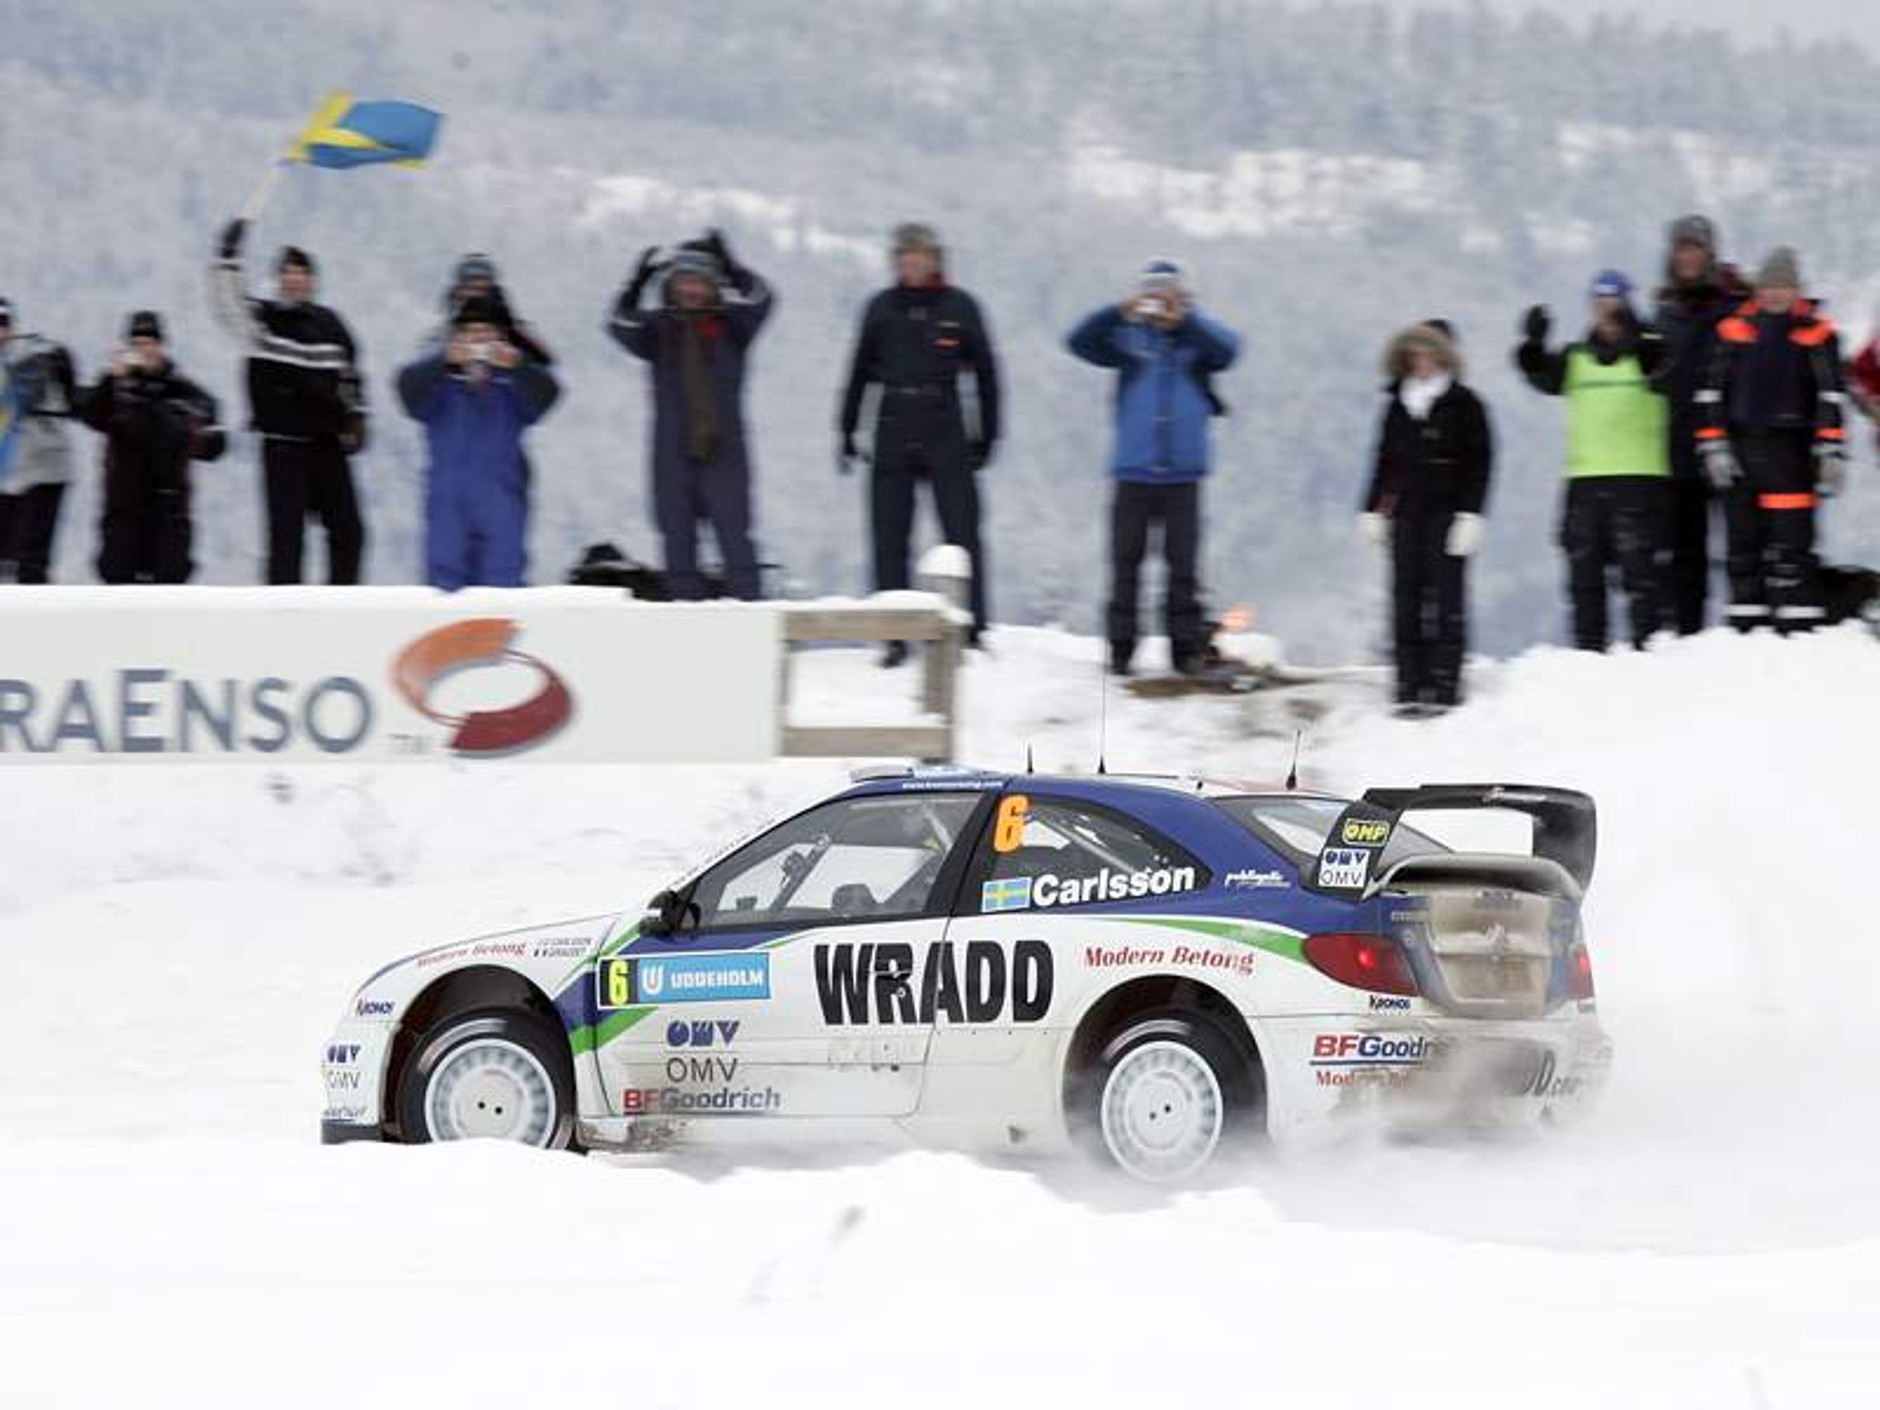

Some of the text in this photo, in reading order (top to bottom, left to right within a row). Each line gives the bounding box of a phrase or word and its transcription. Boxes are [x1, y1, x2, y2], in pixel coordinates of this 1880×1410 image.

[993, 794, 1030, 853] 6
[1345, 824, 1387, 841] OMP
[1032, 866, 1195, 907] Carlsson
[1321, 869, 1361, 885] OMV
[1086, 946, 1165, 967] Modern
[608, 959, 629, 1006] 6
[670, 968, 763, 989] UDDEHOLM
[813, 939, 1055, 1026] WRADD
[666, 1020, 740, 1048] OMV
[665, 1057, 738, 1083] OMV
[623, 1086, 781, 1110] BFGoodrich
